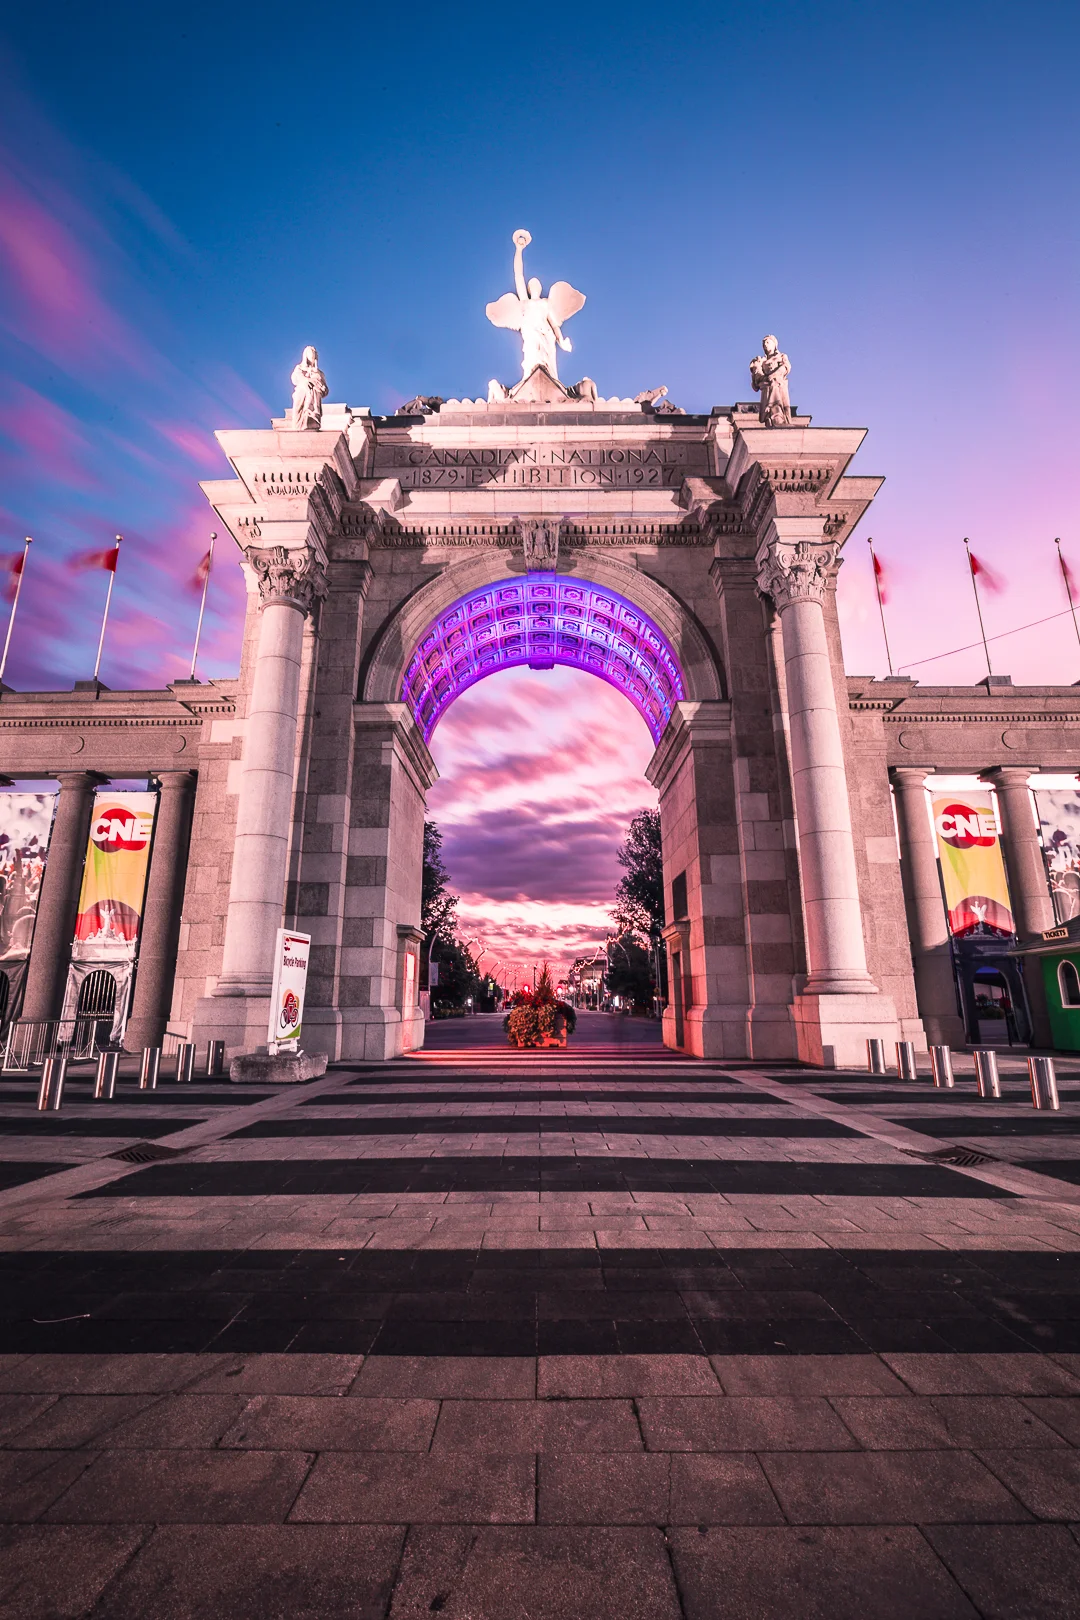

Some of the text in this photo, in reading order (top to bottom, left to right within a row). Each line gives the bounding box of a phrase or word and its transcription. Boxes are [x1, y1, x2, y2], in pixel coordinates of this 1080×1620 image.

[408, 448, 677, 465] CANADIAN NATIONAL
[411, 467, 675, 486] 1879 EXHIBITION 1927
[90, 818, 153, 842] CNE
[935, 814, 997, 838] CNE
[1044, 929, 1066, 939] TICKETS
